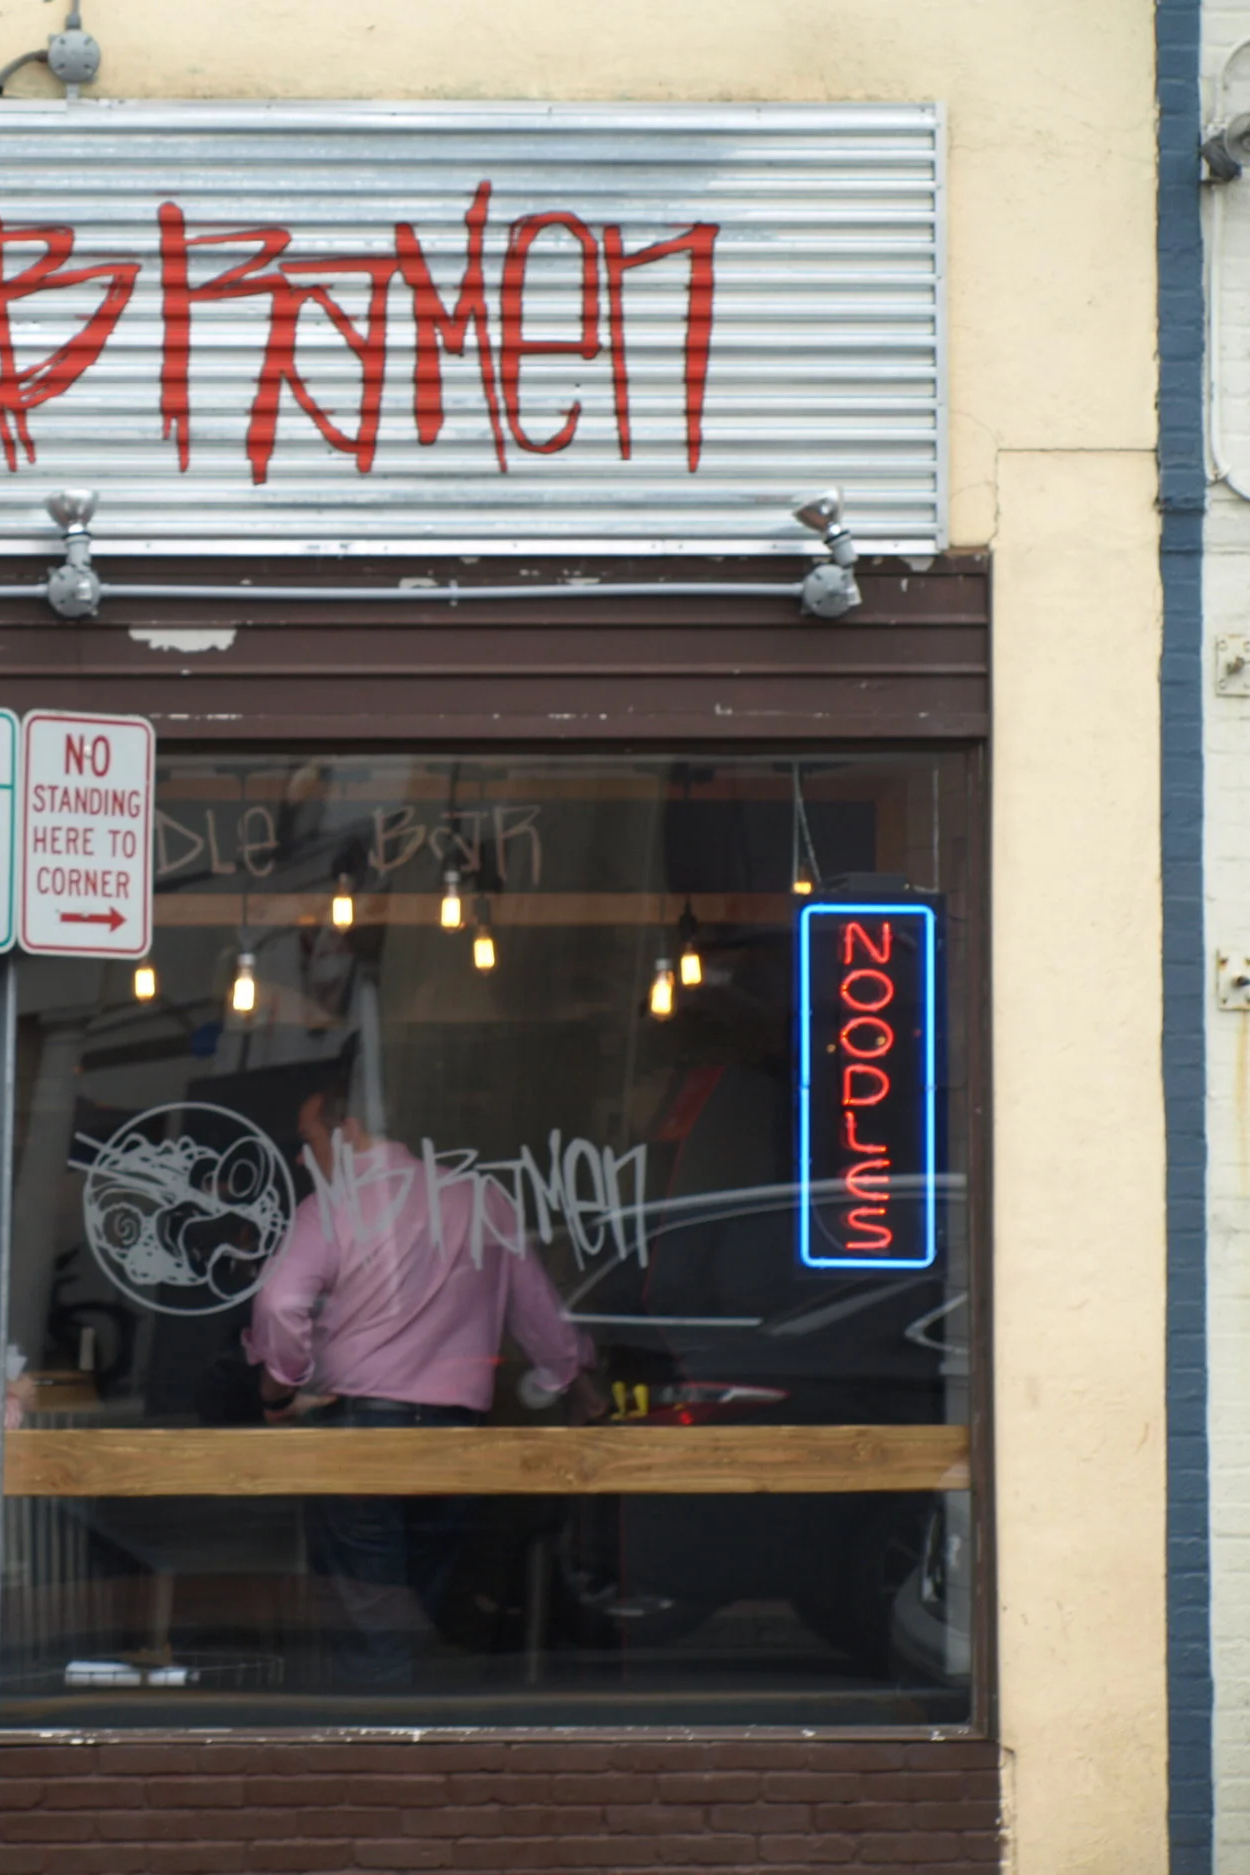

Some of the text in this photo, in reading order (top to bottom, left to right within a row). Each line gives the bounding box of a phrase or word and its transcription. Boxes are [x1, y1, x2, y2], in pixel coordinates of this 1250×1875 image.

[64, 733, 111, 777] NO
[32, 784, 141, 818] STANDING
[33, 826, 136, 859] HERE TO
[36, 866, 130, 900] CORNER
[840, 921, 895, 1250] NOODLES
